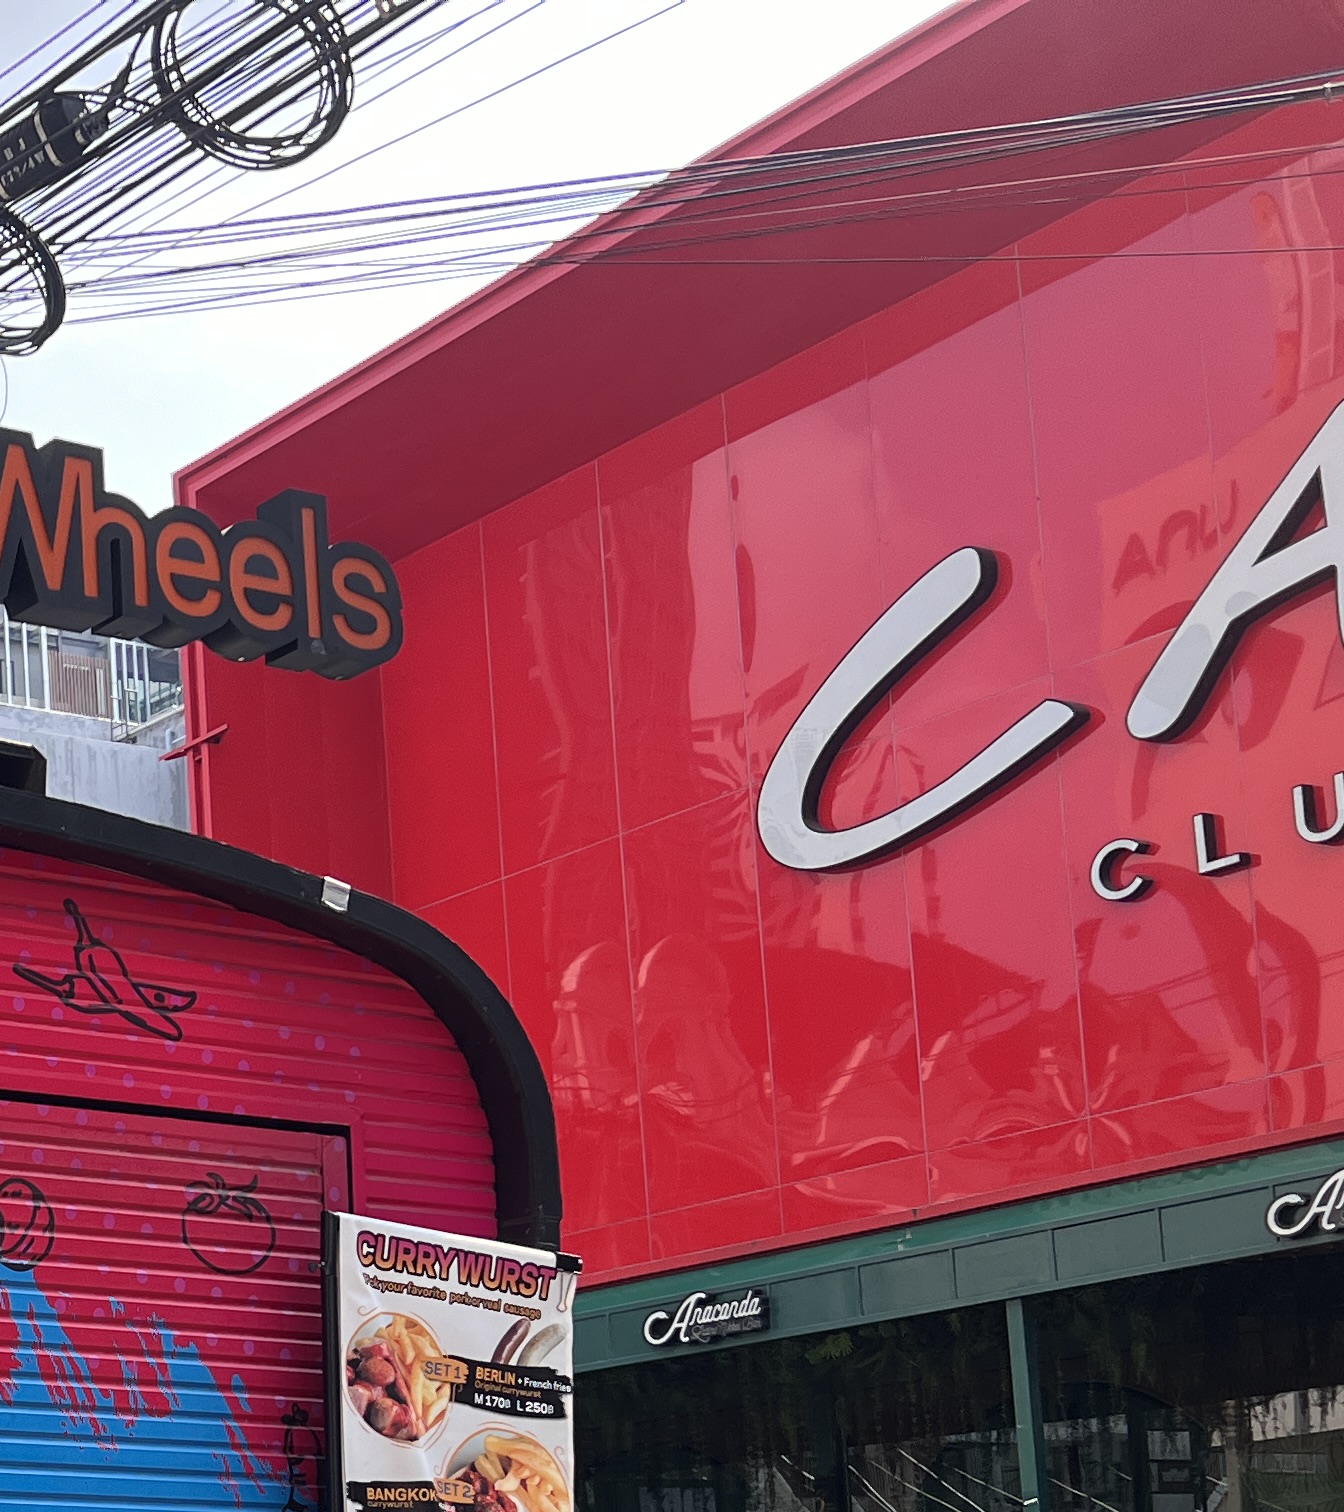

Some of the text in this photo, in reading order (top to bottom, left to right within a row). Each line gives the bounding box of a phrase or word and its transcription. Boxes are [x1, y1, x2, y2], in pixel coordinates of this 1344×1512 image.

[1267, 1169, 1344, 1236] A
[406, 1281, 541, 1319] favorite sausage
[643, 1289, 761, 1345] Anaconda
[424, 1361, 461, 1379] SET 1
[475, 1366, 572, 1392] BERLIN French fries
[474, 1393, 524, 1411] M L
[366, 1487, 437, 1502] BANGKOK
[437, 1480, 472, 1498] SET 2
